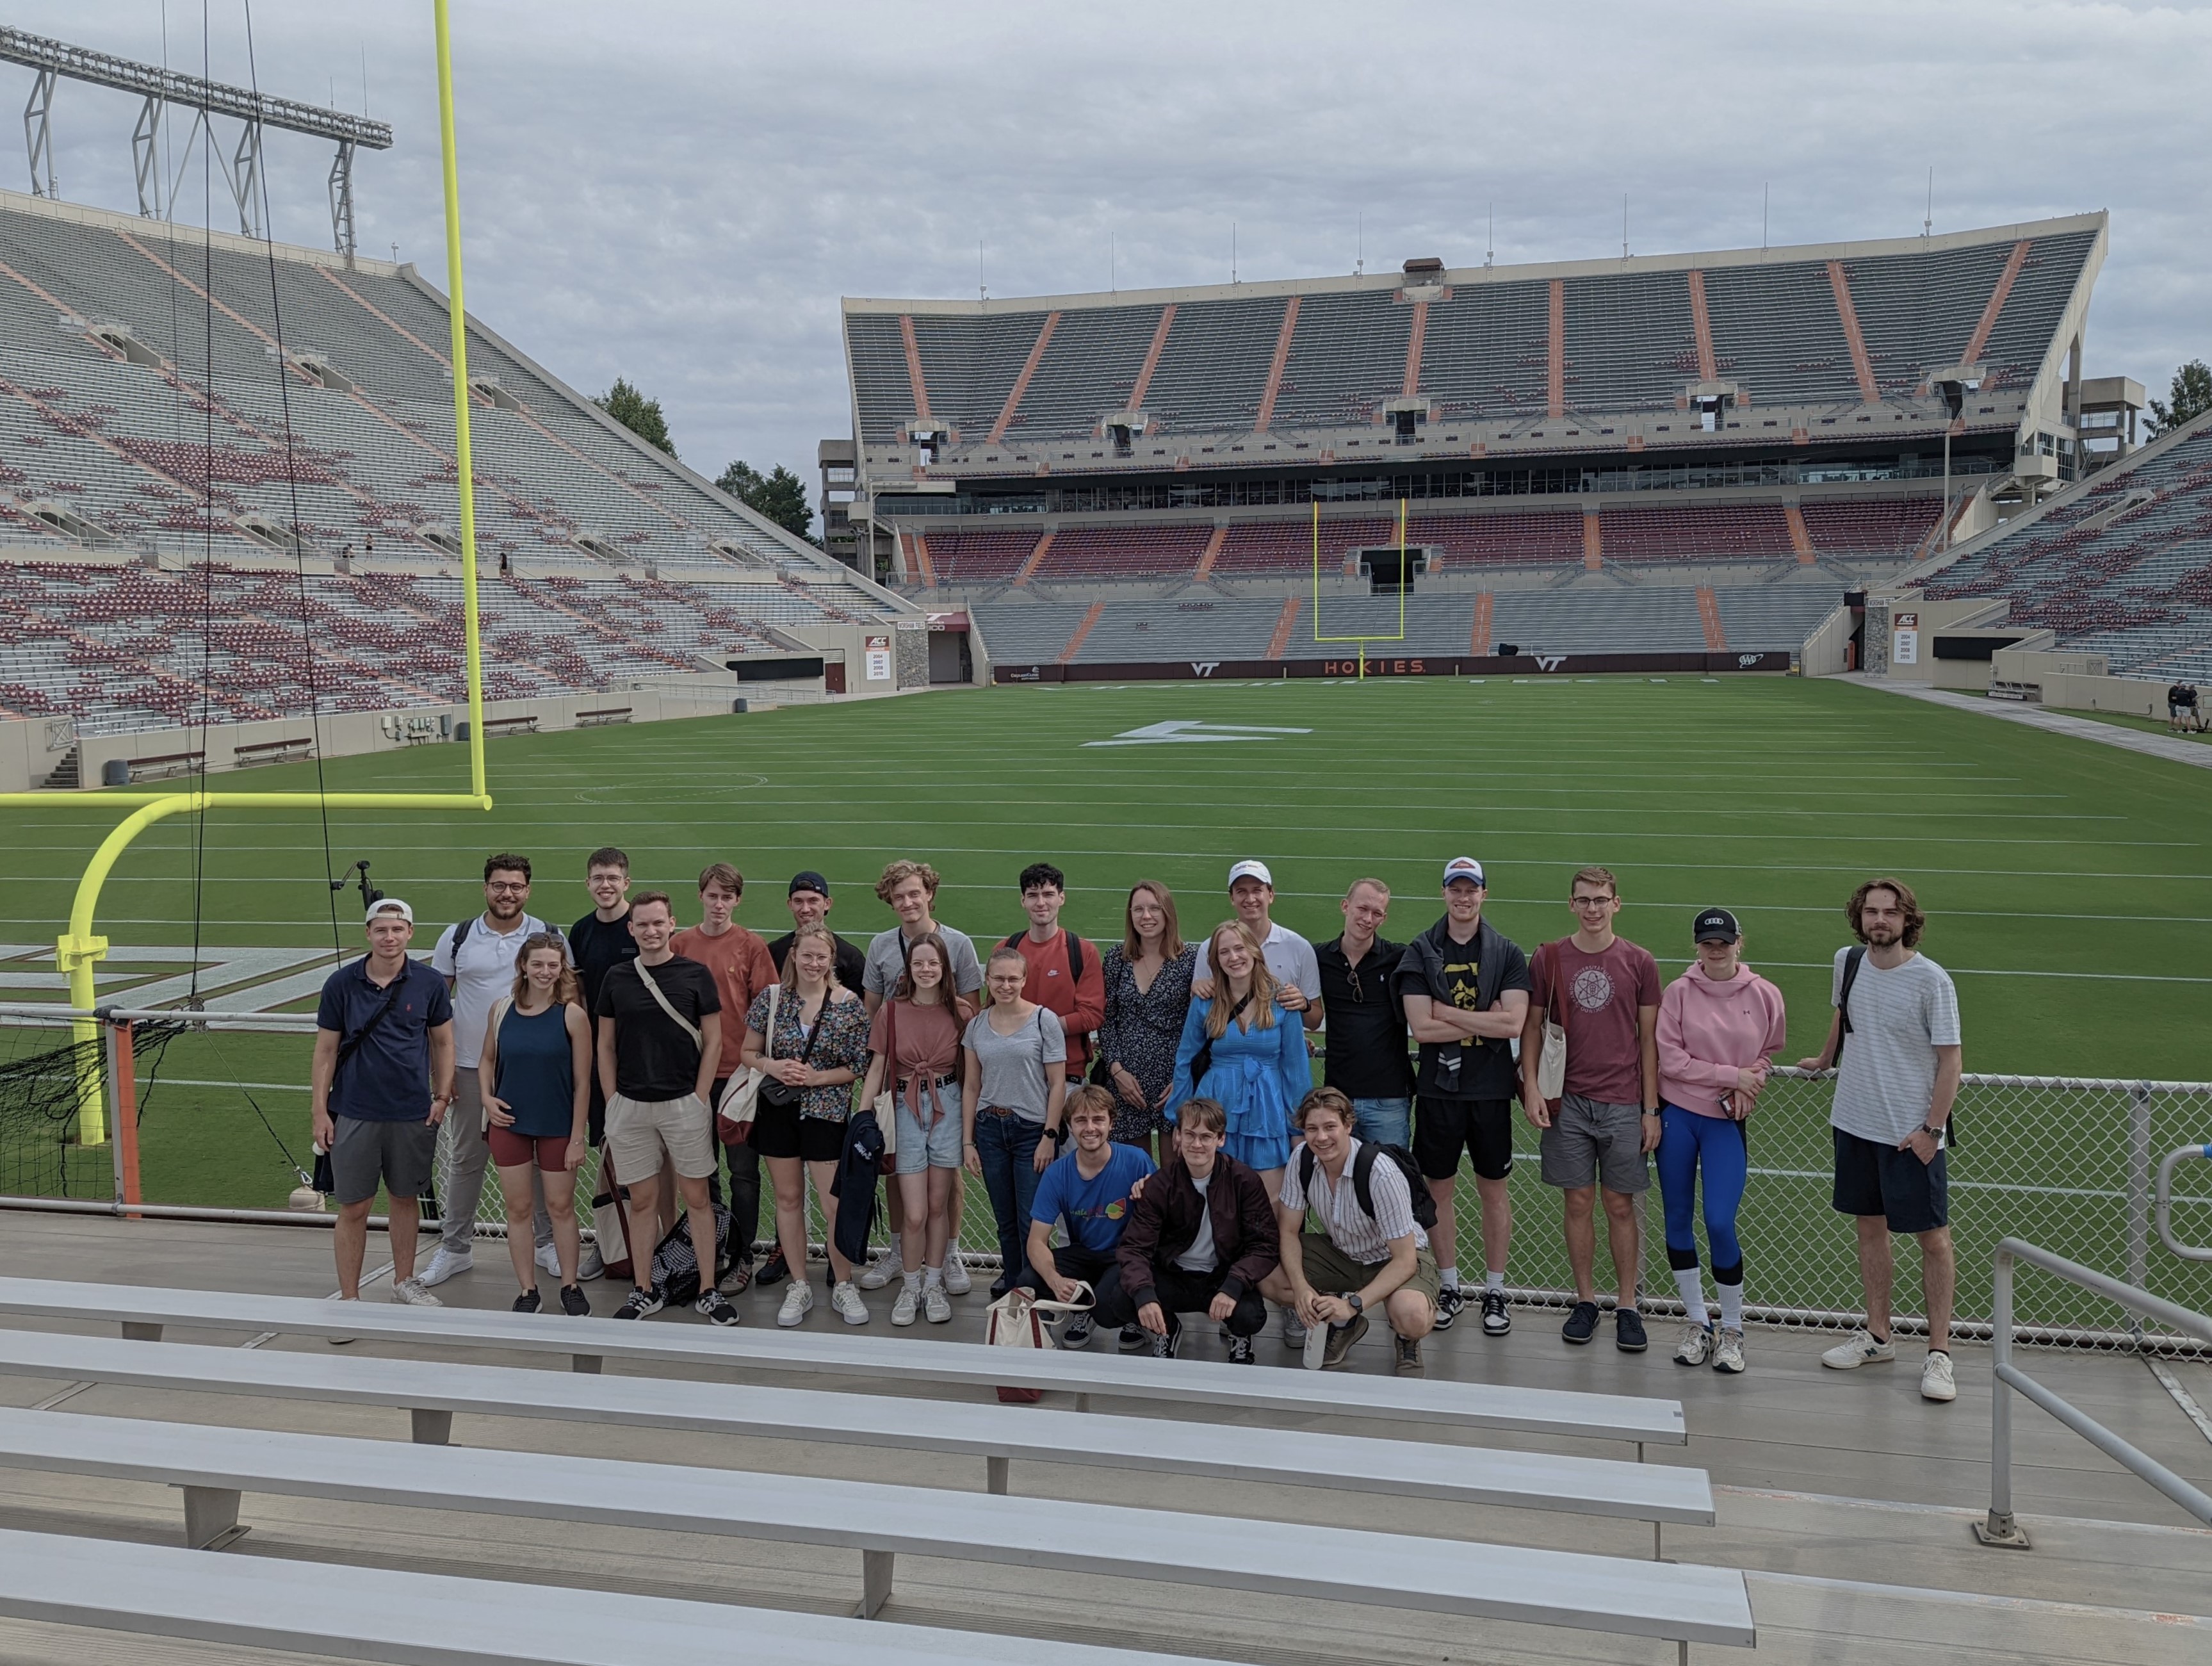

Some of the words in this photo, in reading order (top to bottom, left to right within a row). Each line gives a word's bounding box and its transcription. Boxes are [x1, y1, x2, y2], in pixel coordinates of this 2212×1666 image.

[1191, 662, 1220, 677] VT
[1325, 660, 1424, 674] HOKIES
[1534, 657, 1567, 672] VT
